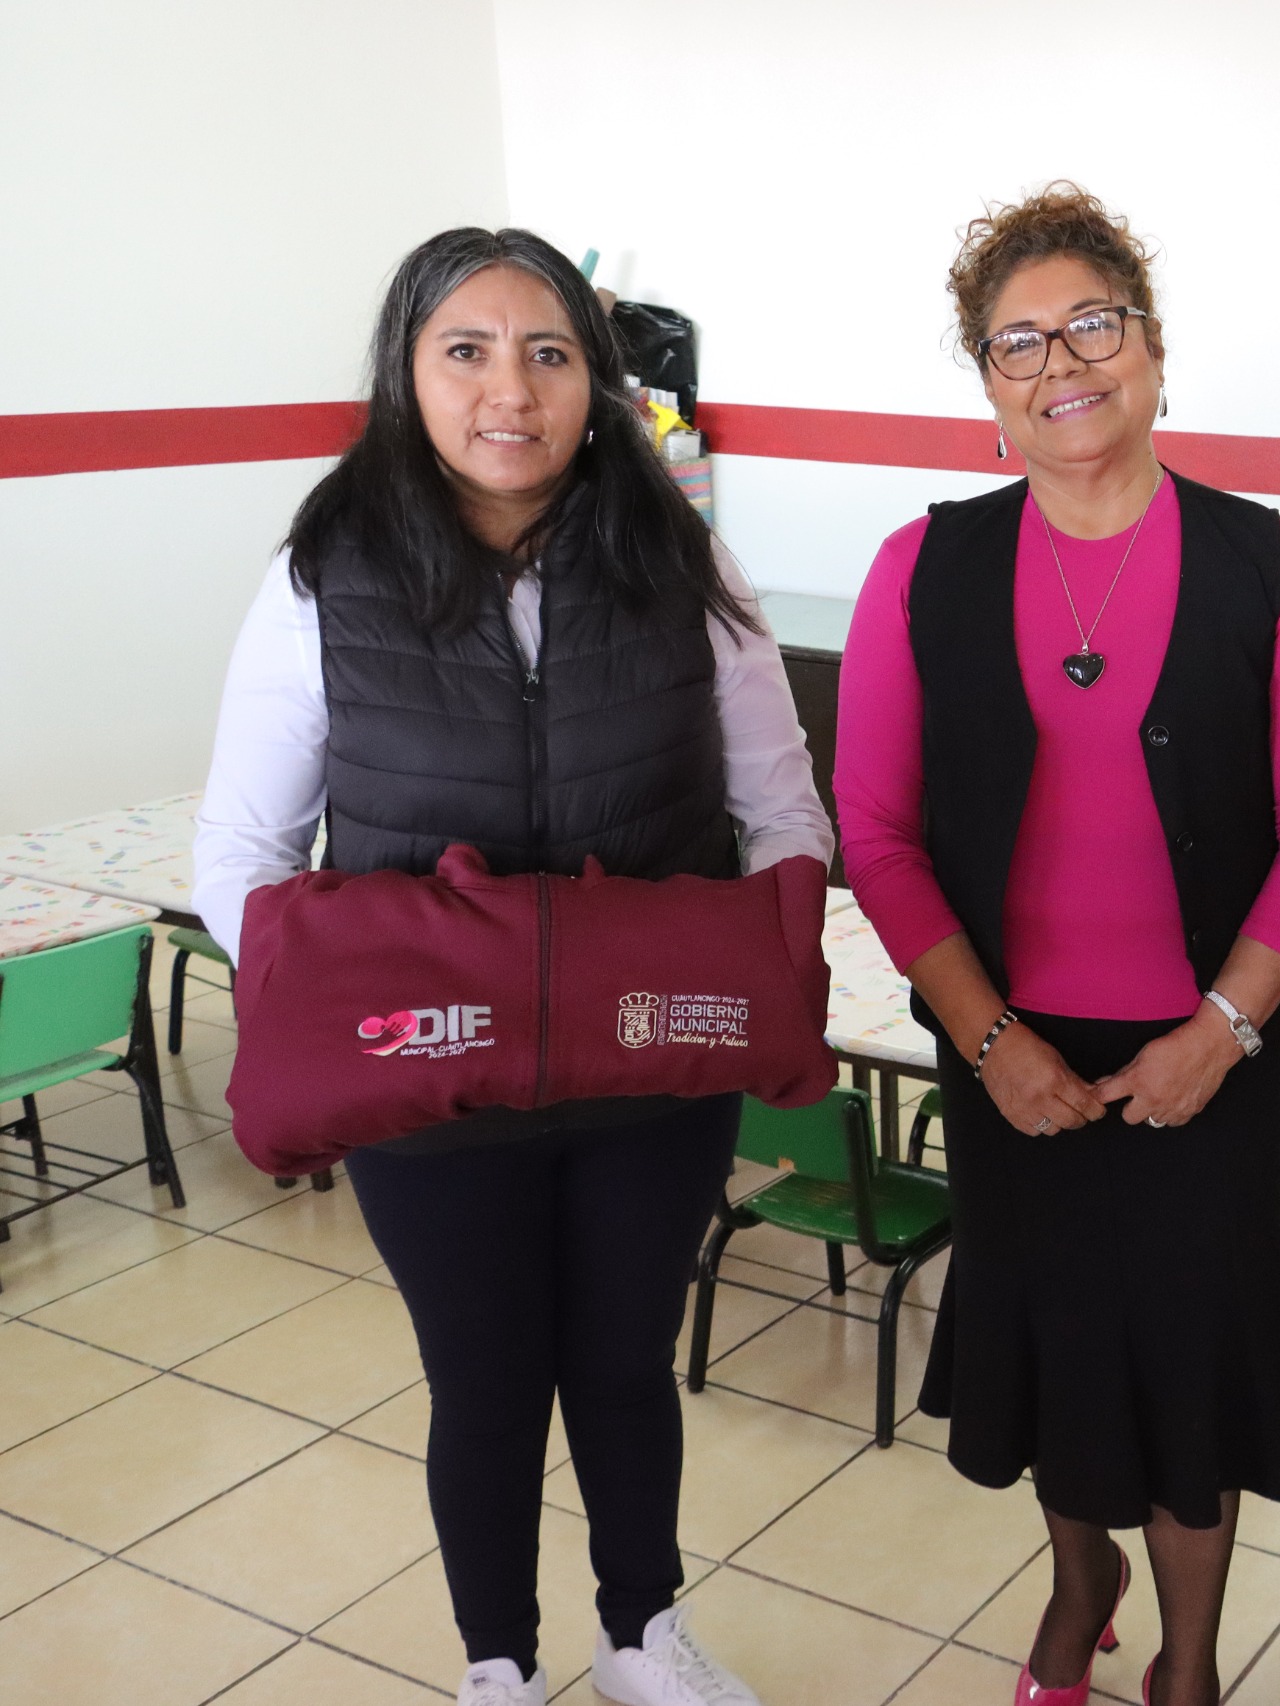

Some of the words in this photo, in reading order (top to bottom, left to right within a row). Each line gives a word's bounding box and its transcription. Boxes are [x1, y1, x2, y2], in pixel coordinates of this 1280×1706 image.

[670, 1004, 748, 1020] GOBIERNO
[408, 1005, 491, 1045] DIF
[669, 1018, 747, 1035] MUNICIPAL
[708, 1037, 717, 1048] y
[719, 1034, 748, 1047] Futuro
